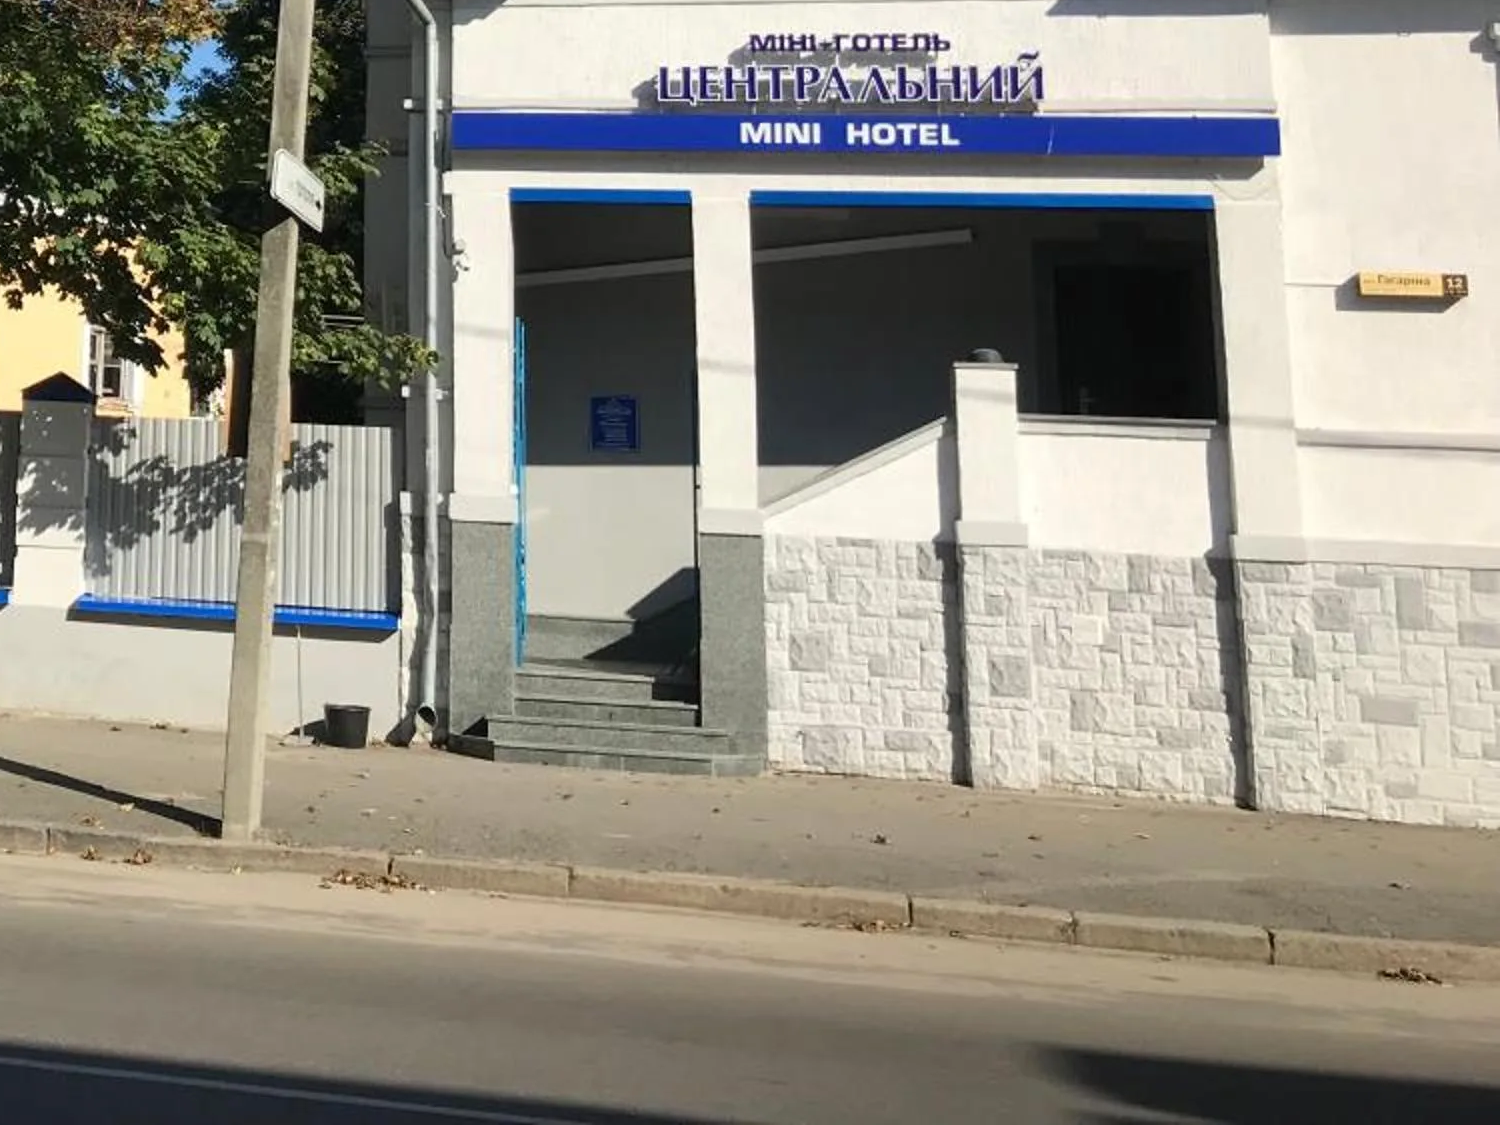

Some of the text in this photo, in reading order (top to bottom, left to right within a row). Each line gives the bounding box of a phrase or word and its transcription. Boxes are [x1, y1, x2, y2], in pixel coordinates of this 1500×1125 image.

[657, 50, 1046, 105] ЦЕНТРАЛЬНИЙ
[740, 122, 961, 146] MINI HOTEL
[1447, 277, 1463, 289] 12
